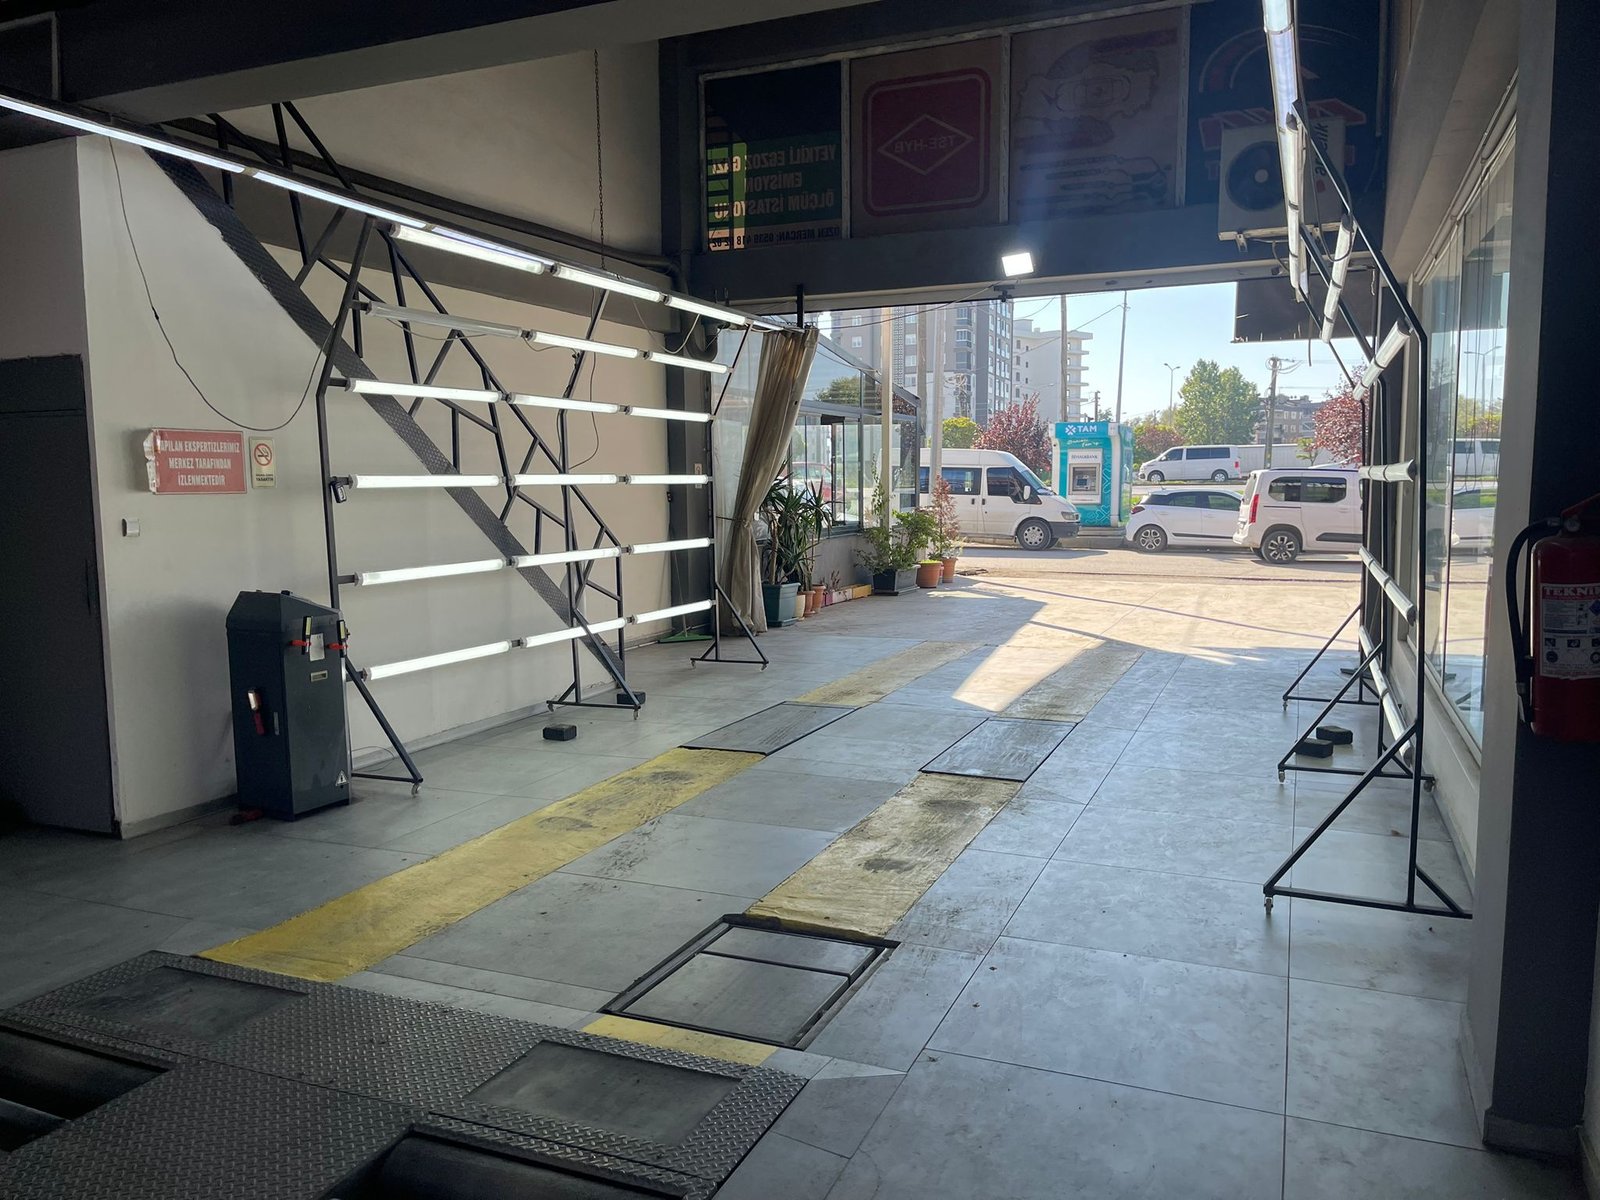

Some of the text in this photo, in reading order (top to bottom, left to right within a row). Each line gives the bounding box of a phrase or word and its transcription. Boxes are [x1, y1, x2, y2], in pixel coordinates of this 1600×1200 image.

[160, 440, 184, 452] APILAN
[168, 457, 232, 469] MERKEZ TARAFINDAN
[177, 471, 226, 486] İZLENMEKTEDİR
